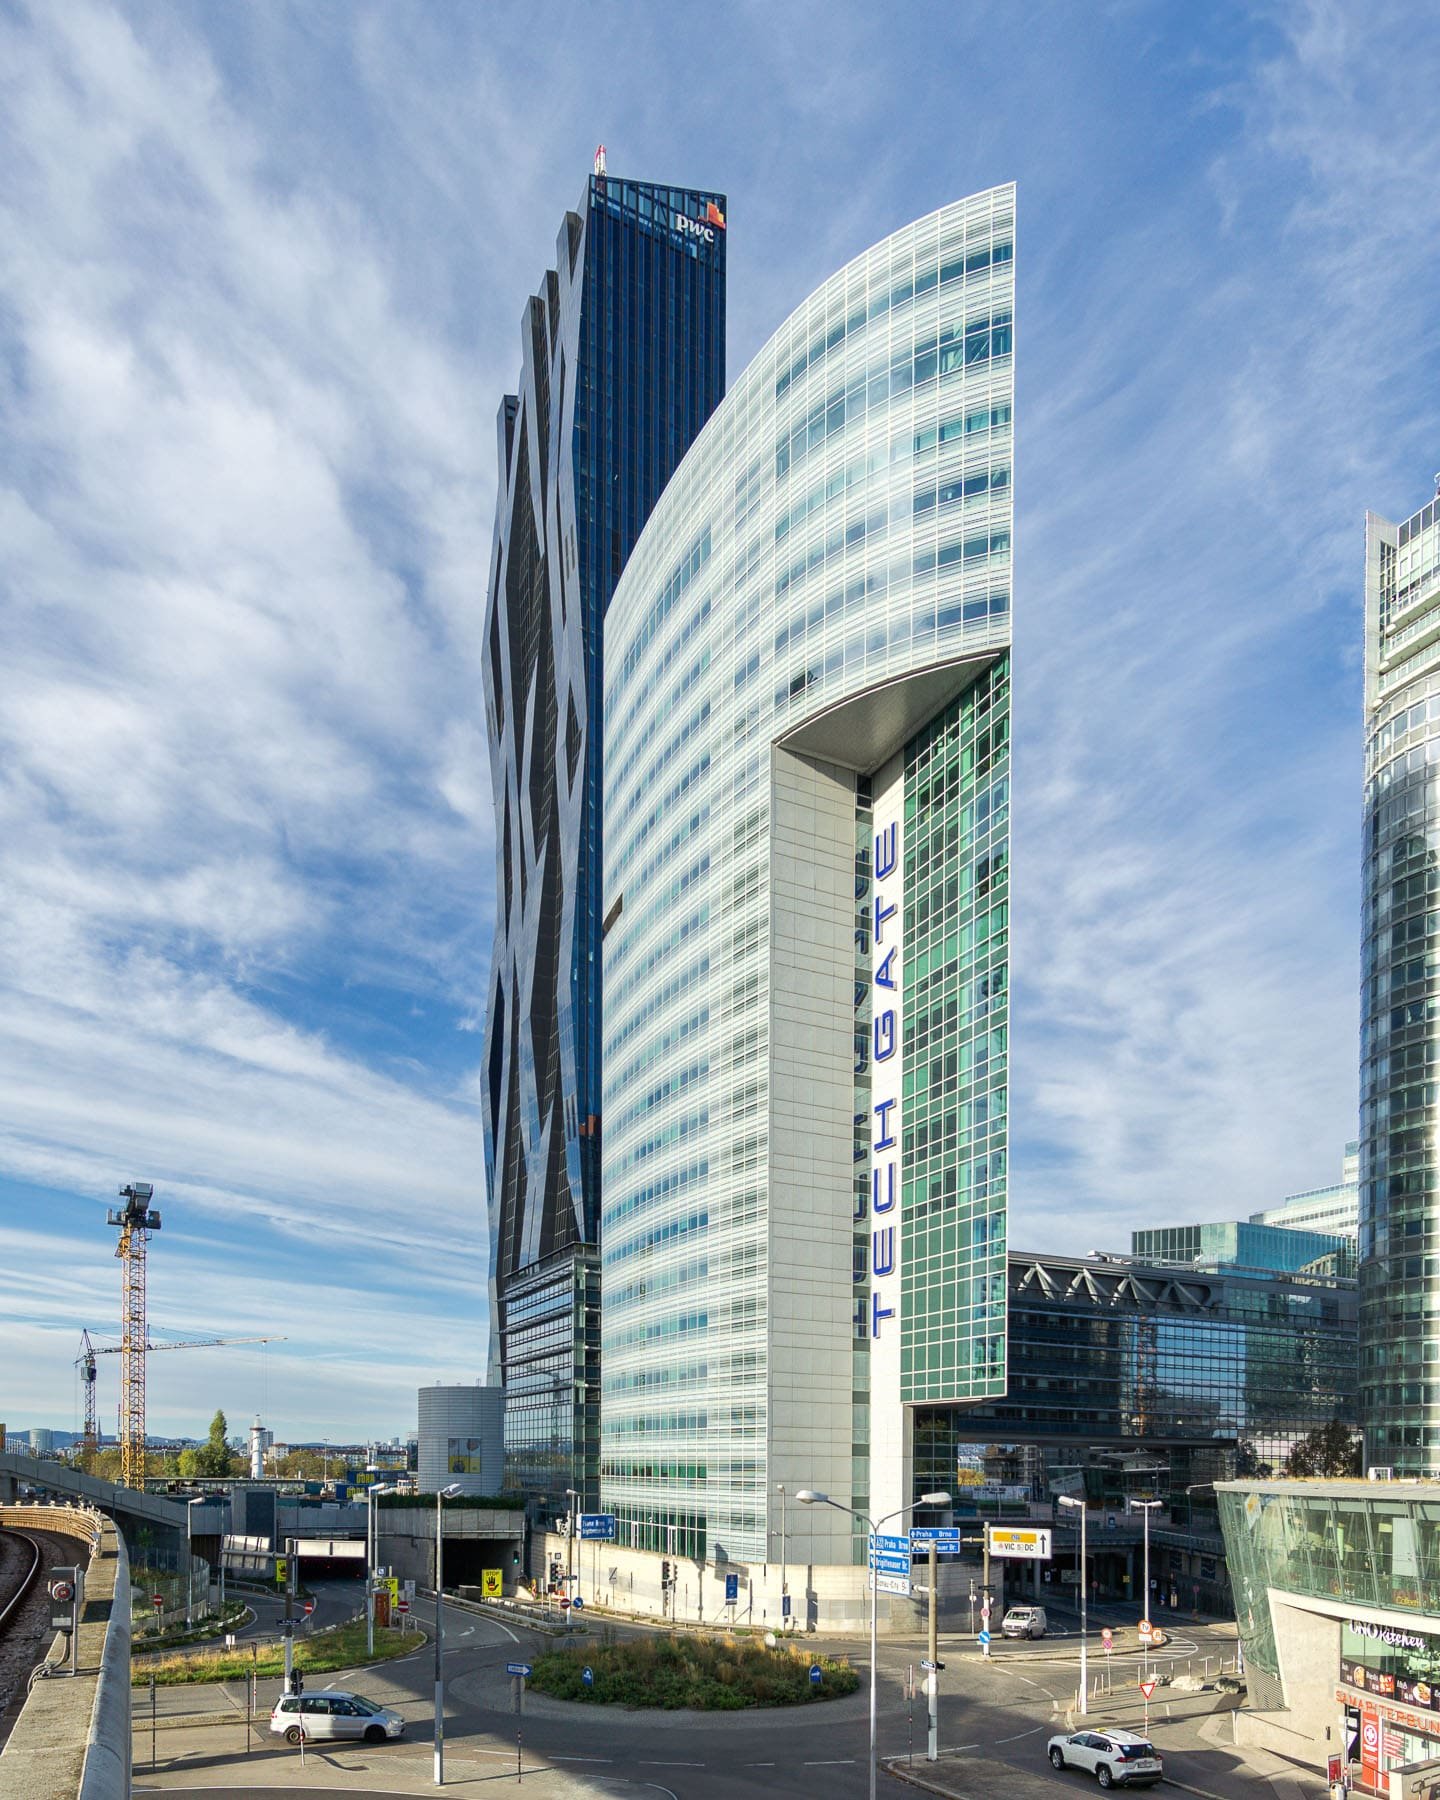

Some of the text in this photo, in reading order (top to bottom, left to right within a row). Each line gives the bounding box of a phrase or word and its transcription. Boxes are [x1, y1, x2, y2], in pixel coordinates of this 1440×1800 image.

[675, 213, 714, 243] pwc
[915, 1530, 952, 1538] Praha Brno
[1349, 1620, 1427, 1649] UNO Kitchen
